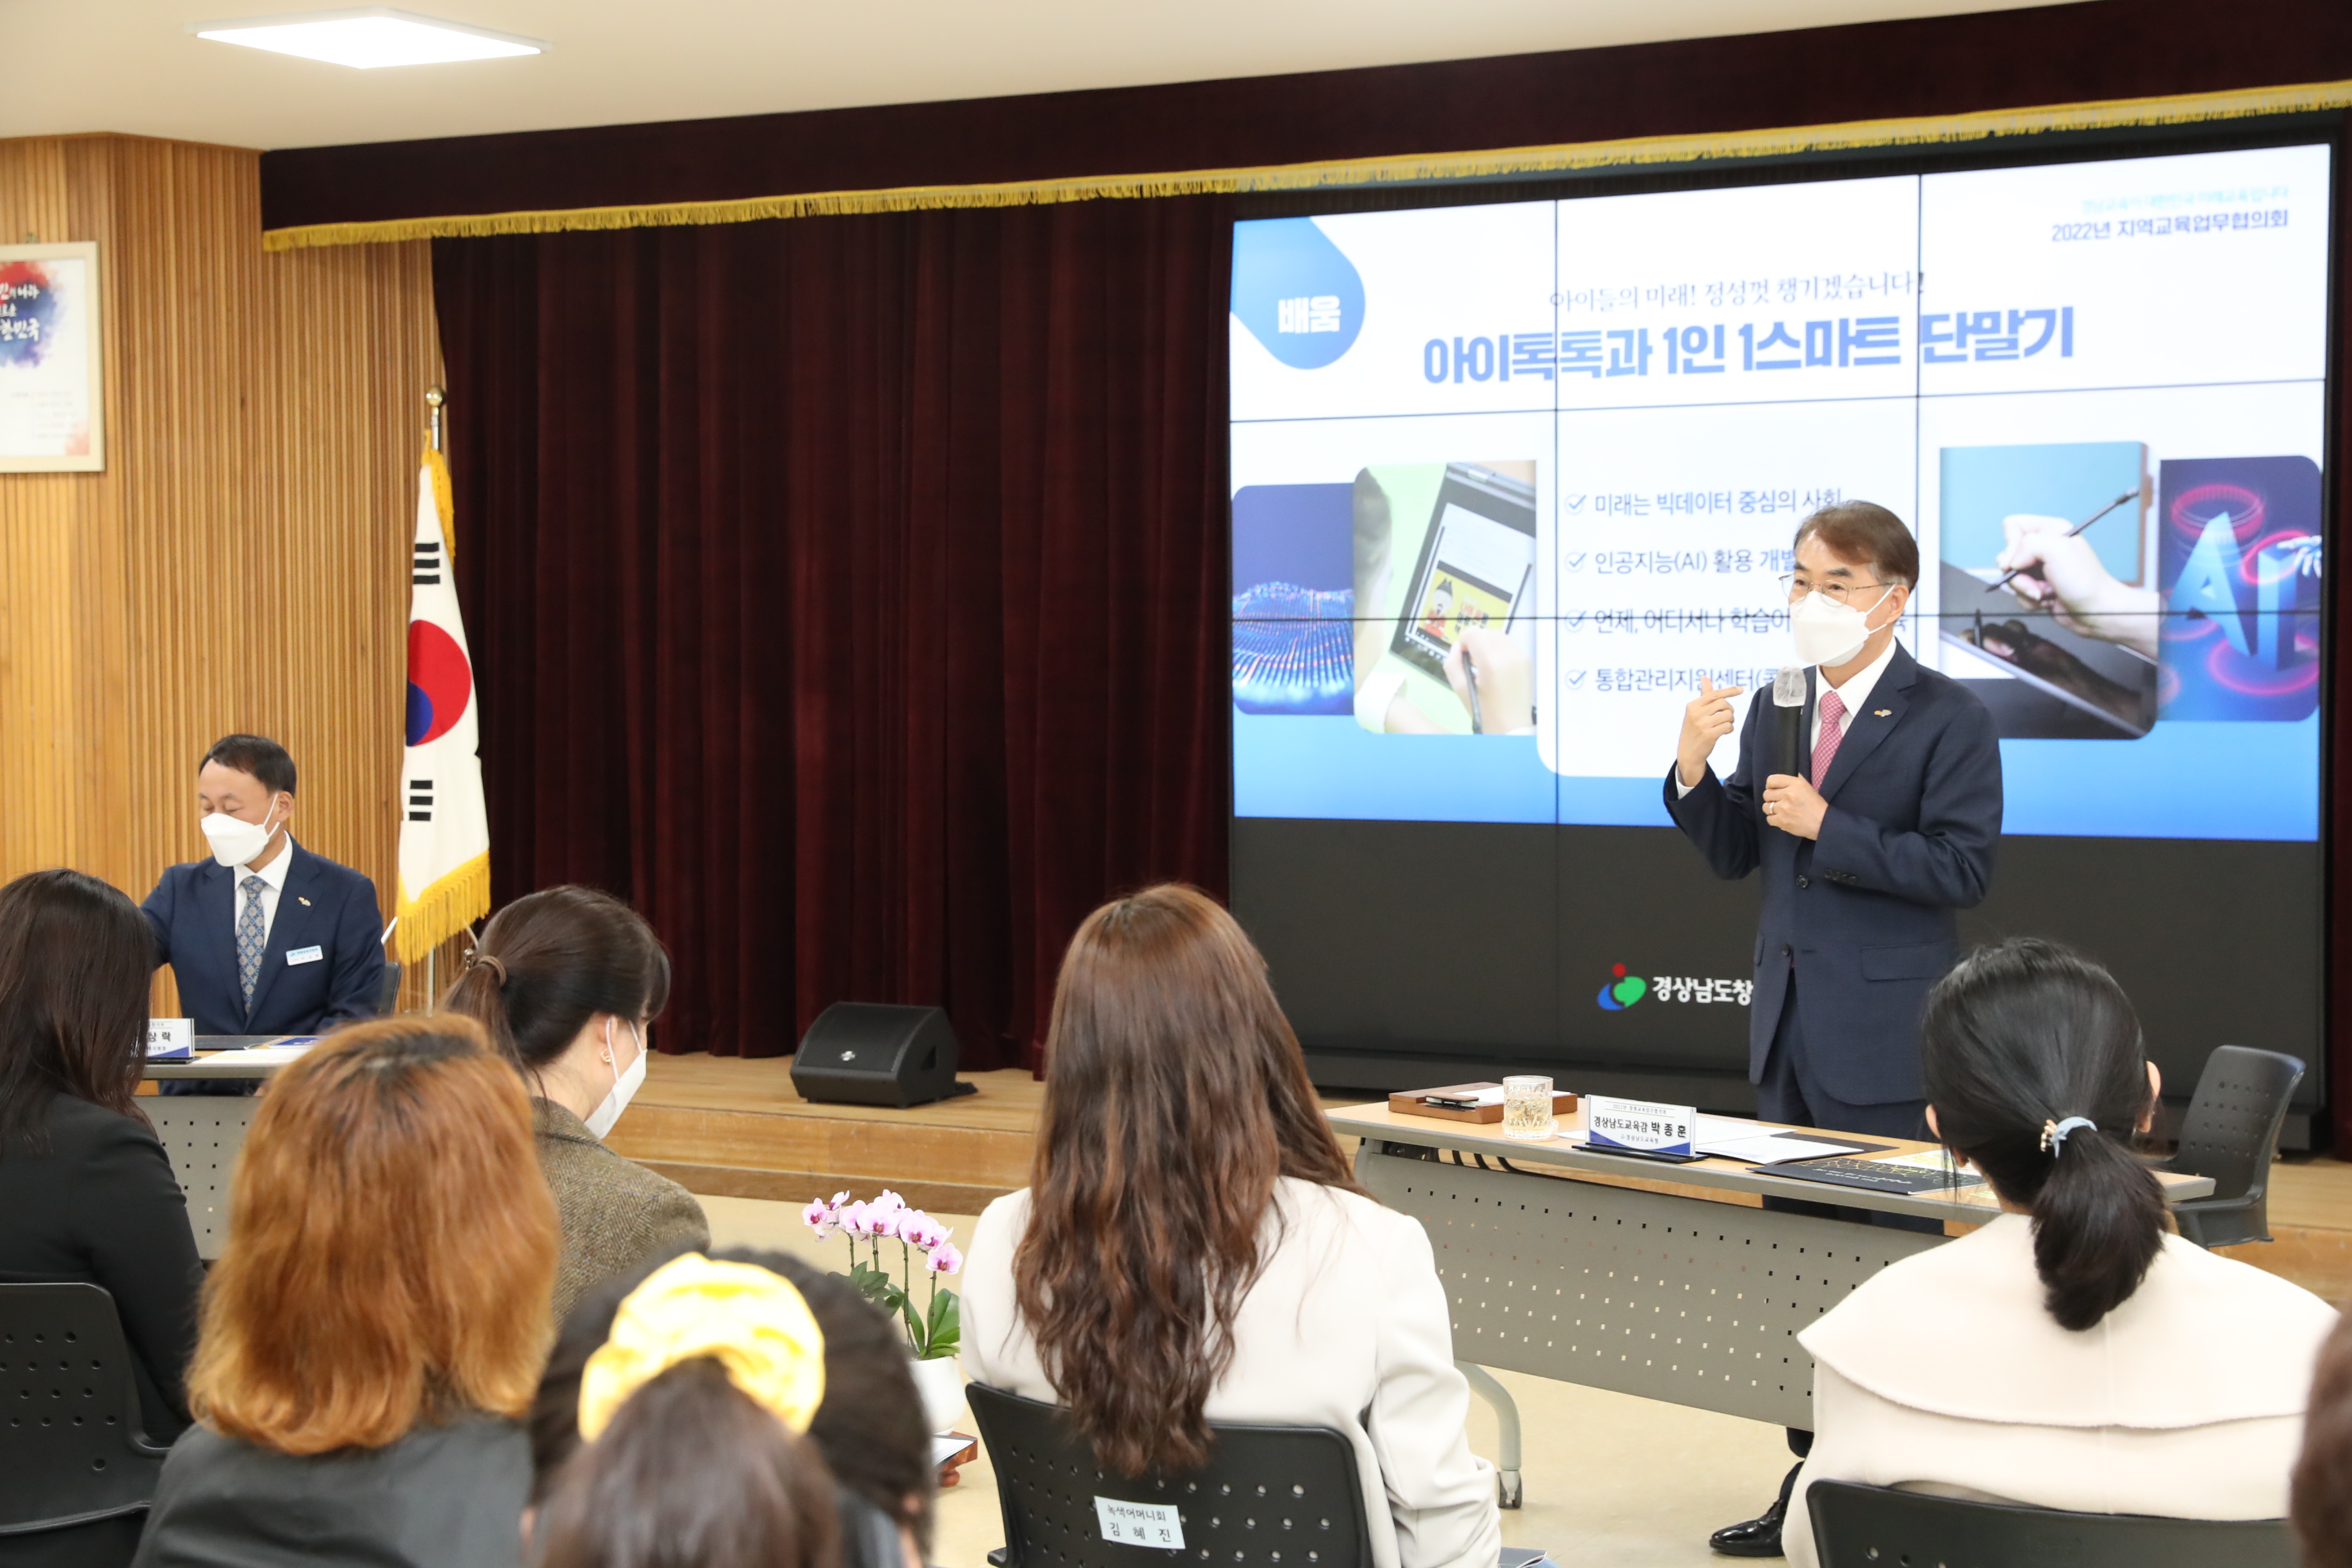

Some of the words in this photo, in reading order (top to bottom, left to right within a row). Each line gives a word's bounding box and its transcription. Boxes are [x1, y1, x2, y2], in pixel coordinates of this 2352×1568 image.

[2052, 221, 2111, 242] 2022년
[2117, 209, 2289, 237] 지역교육업무협의회
[1549, 285, 1638, 313] 아이들의
[1646, 282, 1696, 309] 미래!
[1705, 279, 1770, 307] 정성껏
[1777, 270, 1925, 303] 챙기겠습니다!
[1278, 295, 1341, 333] 배움
[1424, 328, 1653, 384] 아이톡톡과
[1663, 324, 1725, 375] 1인
[1738, 316, 1901, 371] 1스마트
[1919, 306, 2073, 364] 단말기
[1595, 494, 1651, 516] 미래는
[1657, 491, 1732, 515] 빅데이터
[1738, 489, 1797, 514] 중심의
[1595, 550, 1707, 574] 인공지능(AI)
[1714, 549, 1753, 573] 활용
[1594, 609, 1638, 634] 언제,
[1645, 608, 1725, 633] 어디서나
[1730, 607, 1790, 632] 학습이
[1652, 975, 1754, 1006] 경상남도창
[1594, 1116, 1648, 1133] 경상남도교육감
[1626, 1134, 1659, 1144] 경상남도교육청
[1108, 1504, 1166, 1522] 녹색어머니회
